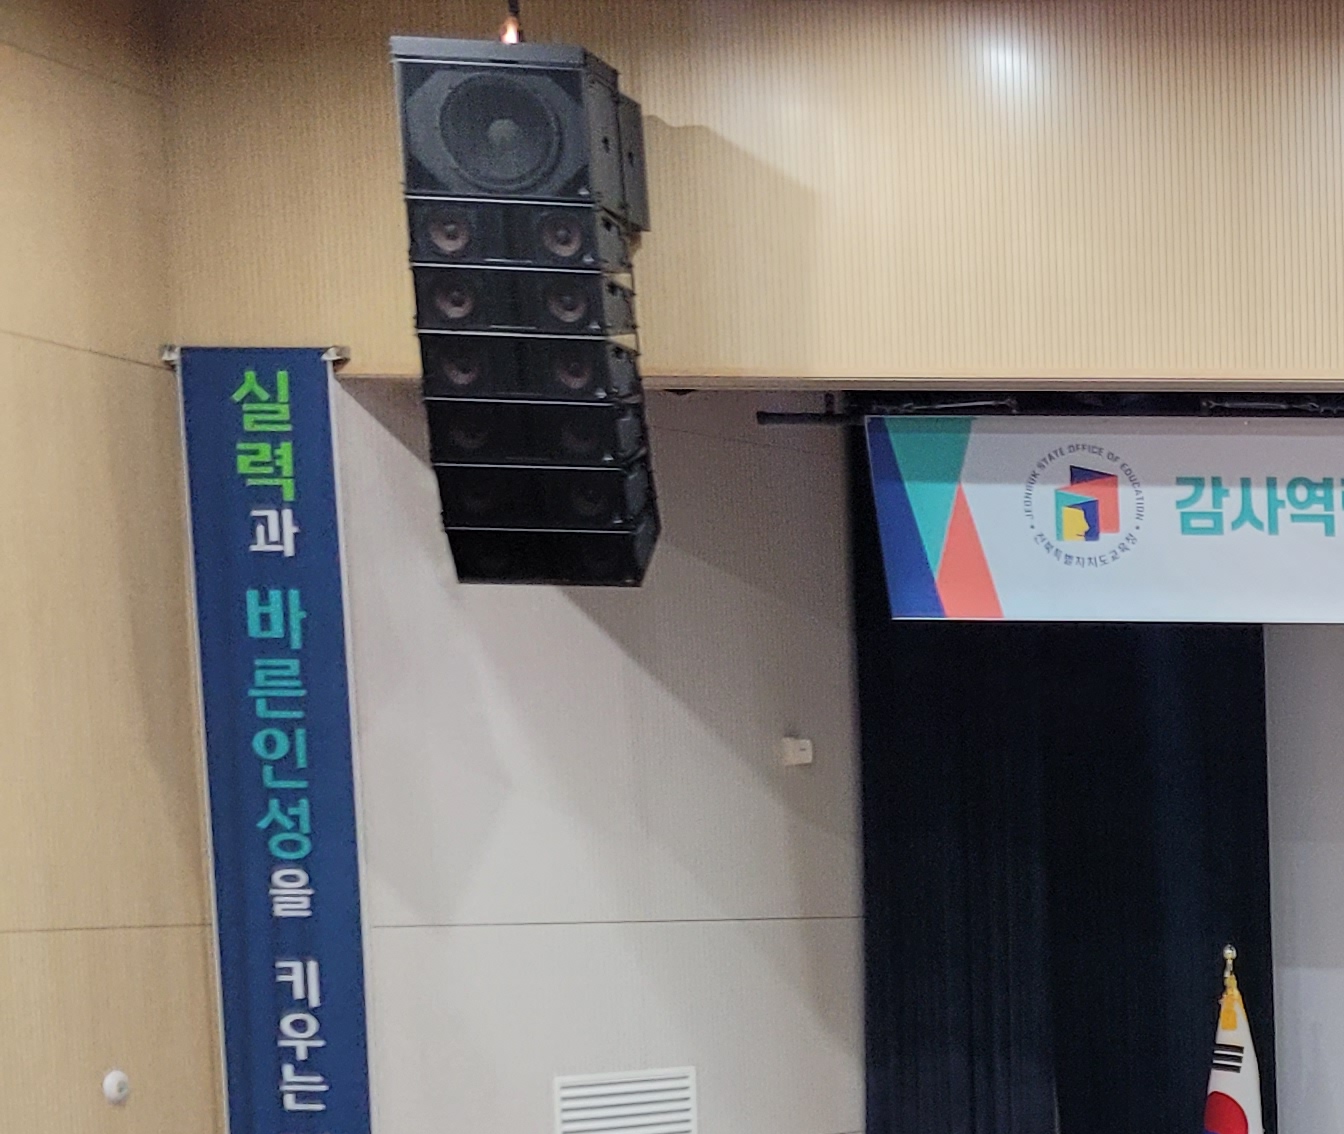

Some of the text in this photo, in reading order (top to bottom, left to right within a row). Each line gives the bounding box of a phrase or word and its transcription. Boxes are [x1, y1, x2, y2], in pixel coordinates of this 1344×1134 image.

[1037, 447, 1066, 471] STATE
[1067, 443, 1104, 457] OFFICE
[1107, 451, 1120, 463] OF
[1120, 463, 1145, 521] EDUCATION
[232, 370, 300, 558] 실력과
[274, 959, 329, 1112] 키우는
